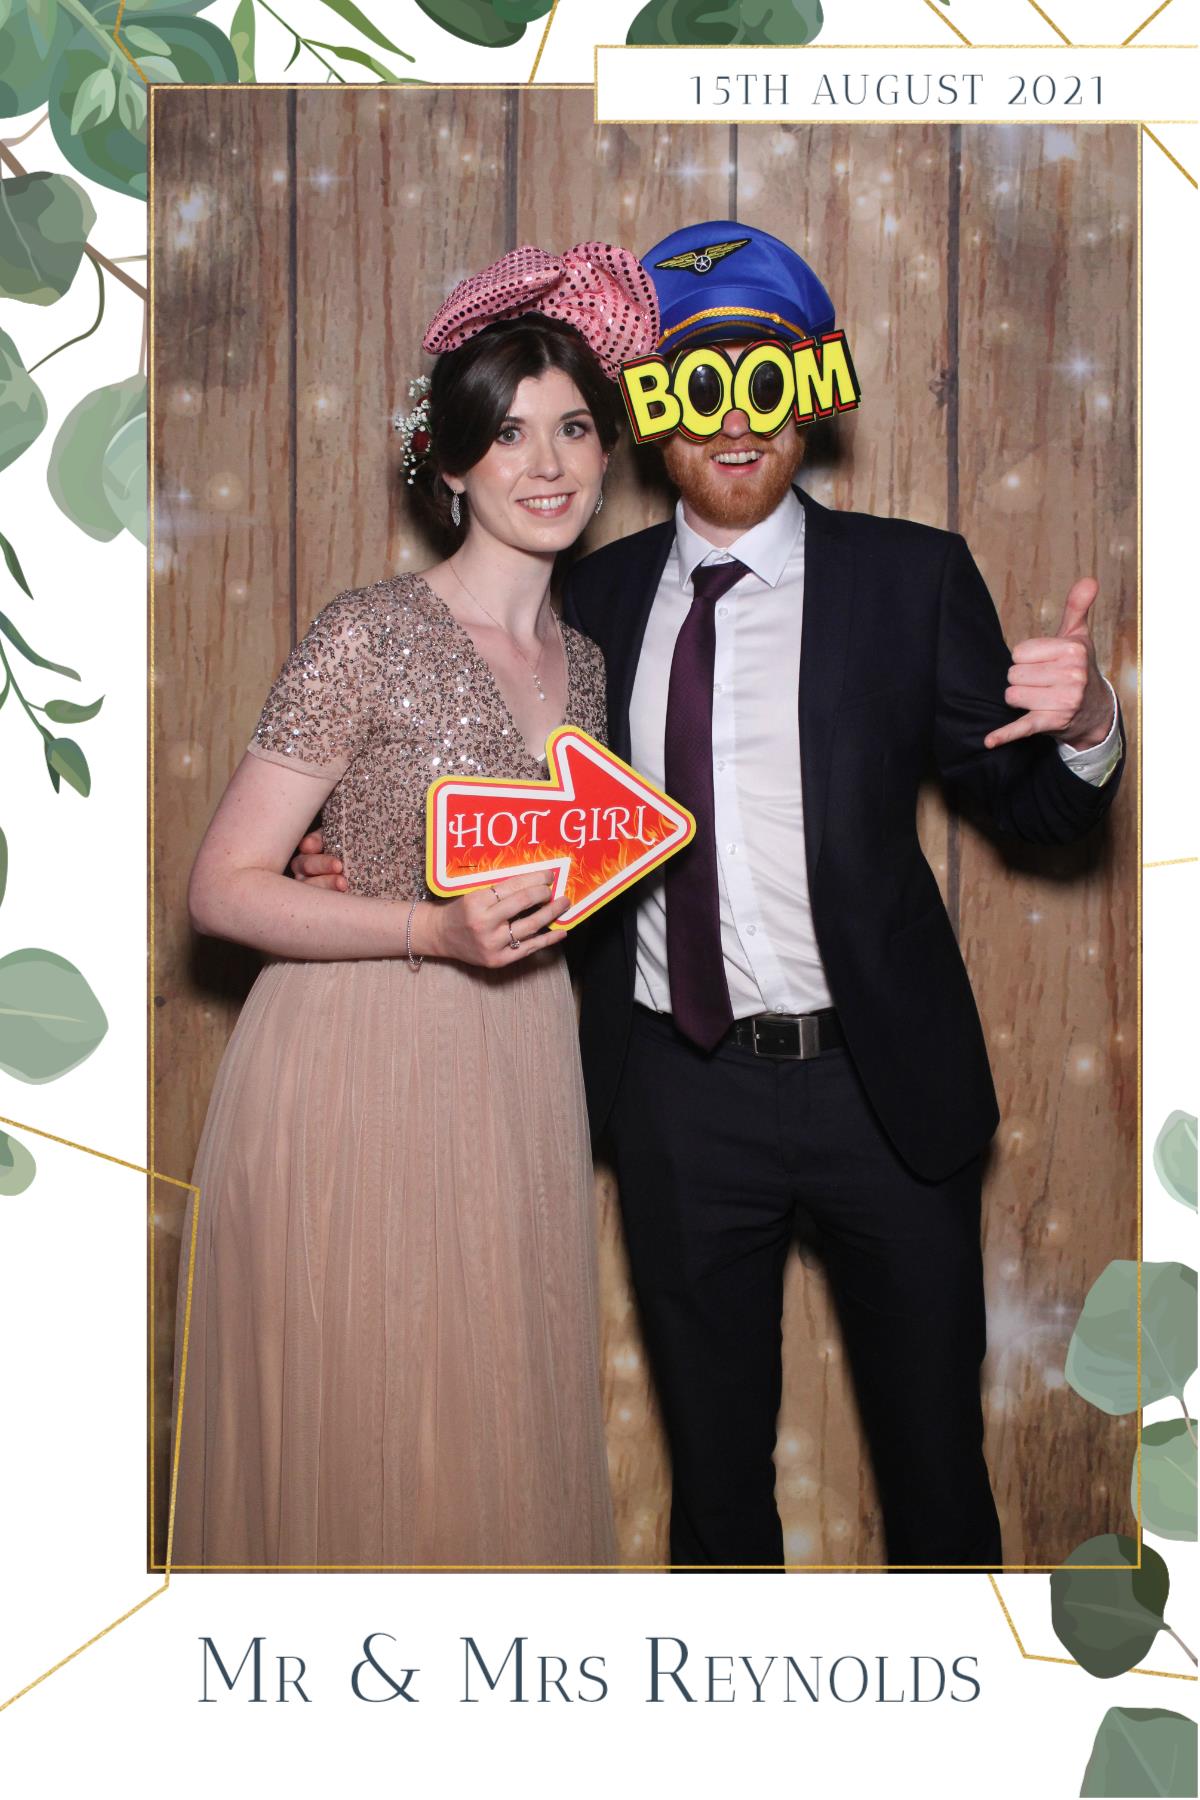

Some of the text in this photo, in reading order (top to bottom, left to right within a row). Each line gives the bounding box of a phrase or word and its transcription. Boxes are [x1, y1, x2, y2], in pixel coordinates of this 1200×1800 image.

[619, 330, 862, 444] BOOM
[449, 804, 657, 850] HOT GIRL
